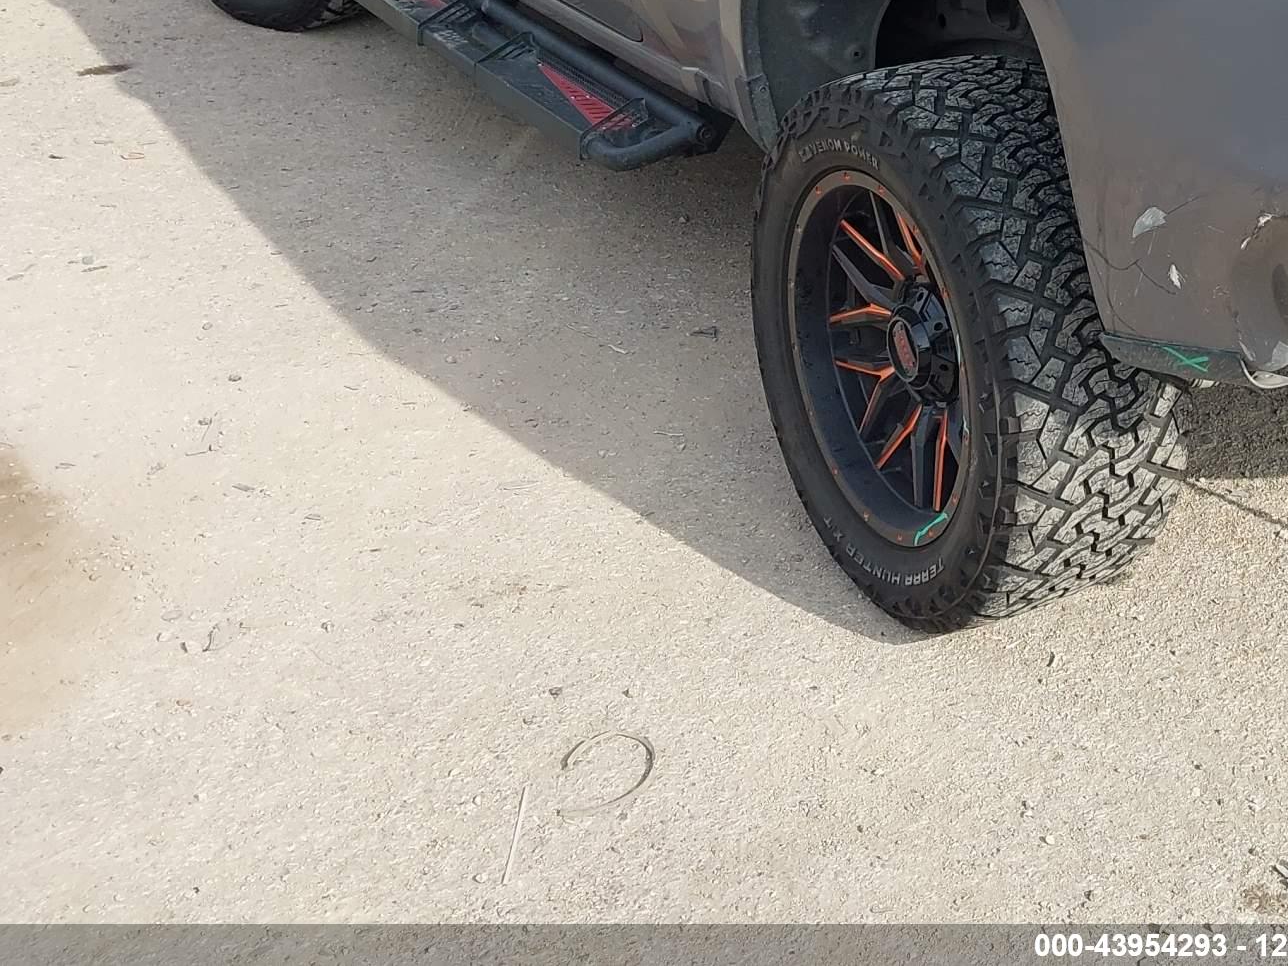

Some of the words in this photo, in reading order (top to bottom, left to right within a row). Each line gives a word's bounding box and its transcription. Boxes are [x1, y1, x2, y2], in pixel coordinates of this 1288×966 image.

[809, 138, 842, 155] VENOM
[843, 140, 879, 171] POWER
[845, 542, 901, 585] HUNTER
